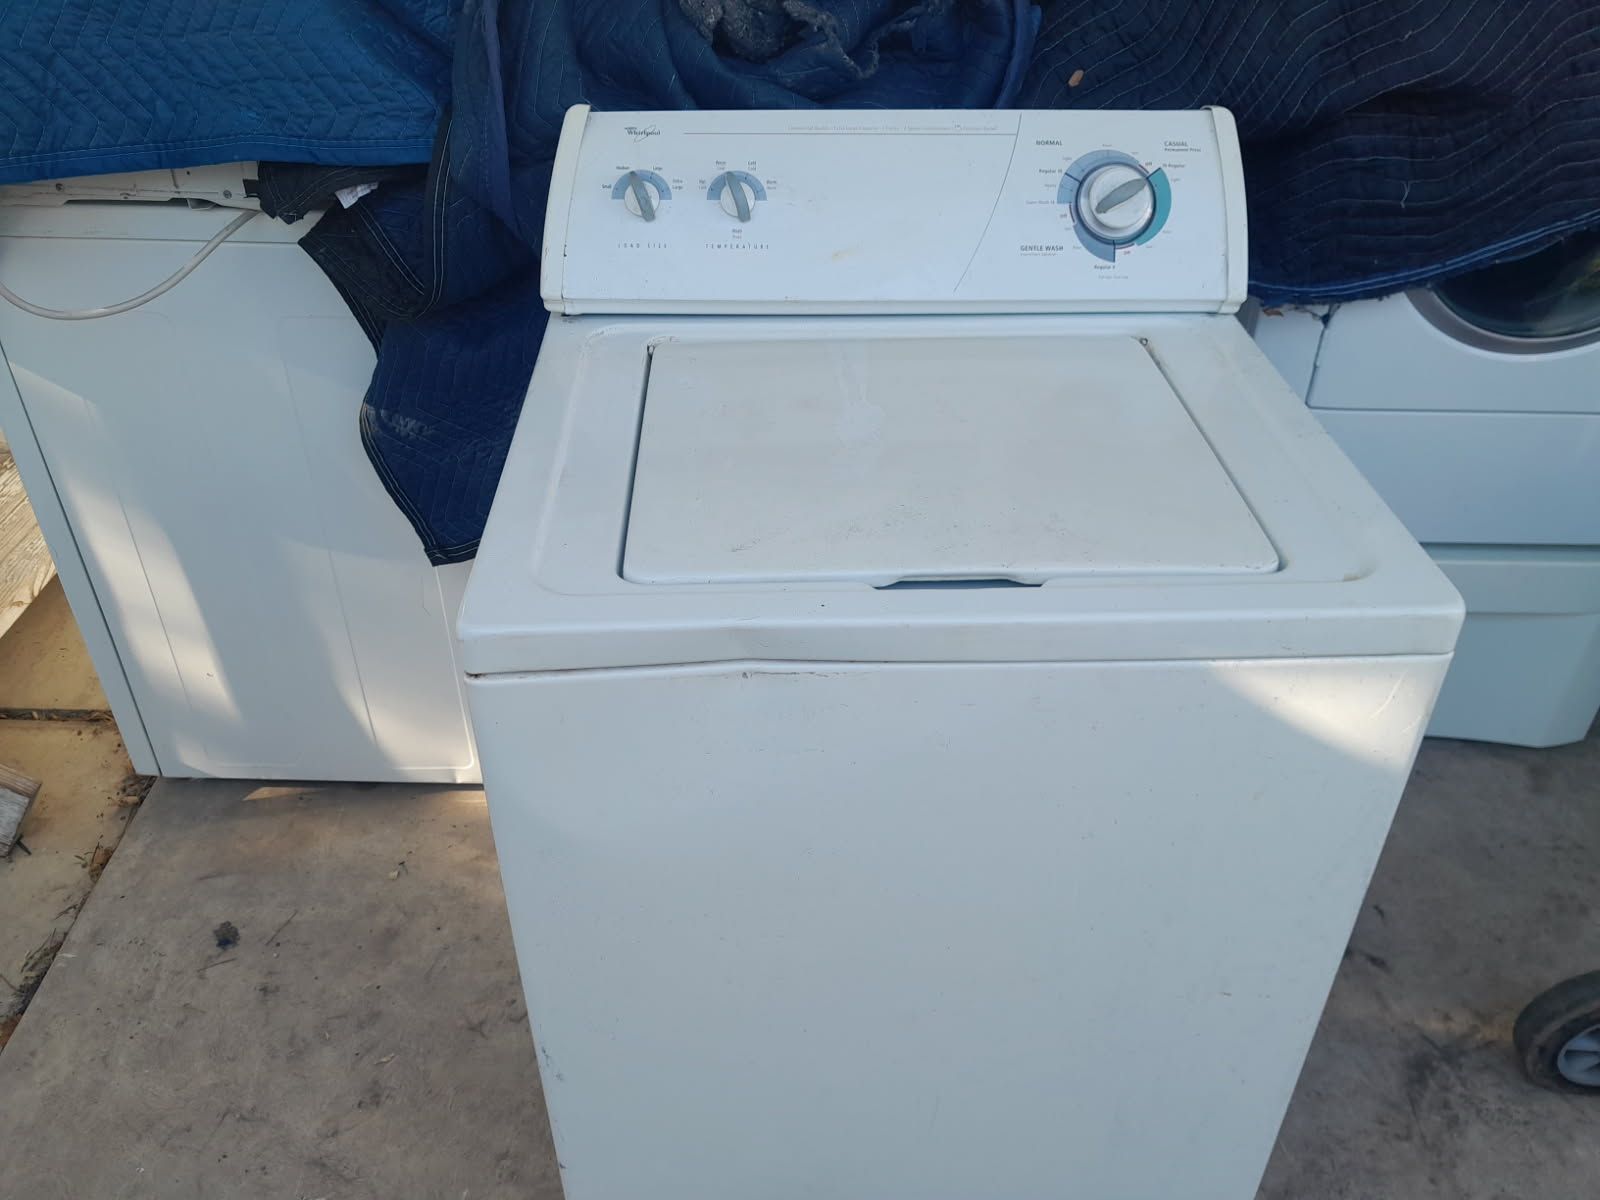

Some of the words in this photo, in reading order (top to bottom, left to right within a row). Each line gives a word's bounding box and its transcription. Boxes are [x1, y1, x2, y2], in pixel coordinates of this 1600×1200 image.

[624, 126, 661, 137] Whirlpool
[704, 242, 769, 250] TEMPERATURE
[1020, 244, 1044, 252] GENTLE
[1045, 244, 1064, 252] WASH
